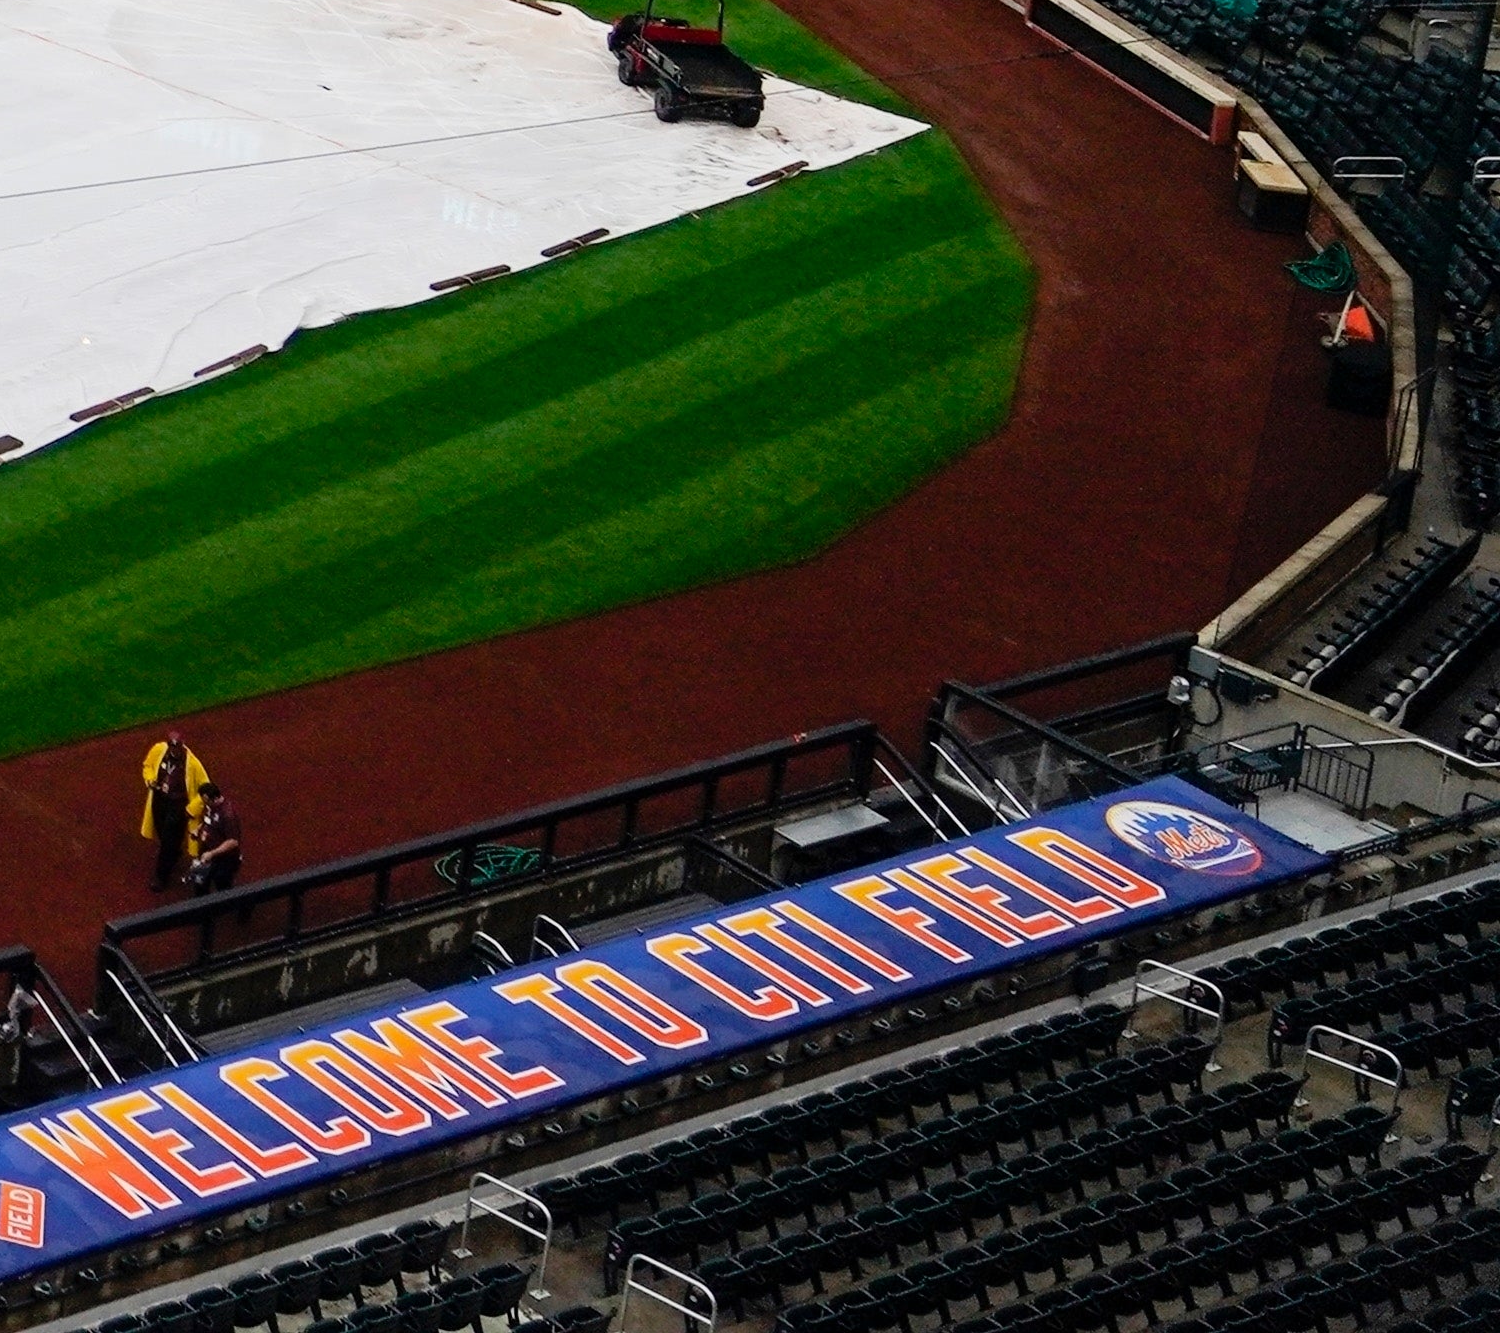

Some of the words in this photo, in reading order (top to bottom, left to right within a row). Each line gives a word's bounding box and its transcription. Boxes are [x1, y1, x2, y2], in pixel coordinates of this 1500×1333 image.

[8, 1001, 566, 1219] WELCOME
[492, 961, 708, 1065] TO
[645, 900, 913, 1022] CITI
[831, 827, 1167, 964] FIELD
[7, 1188, 35, 1242] FIELD
